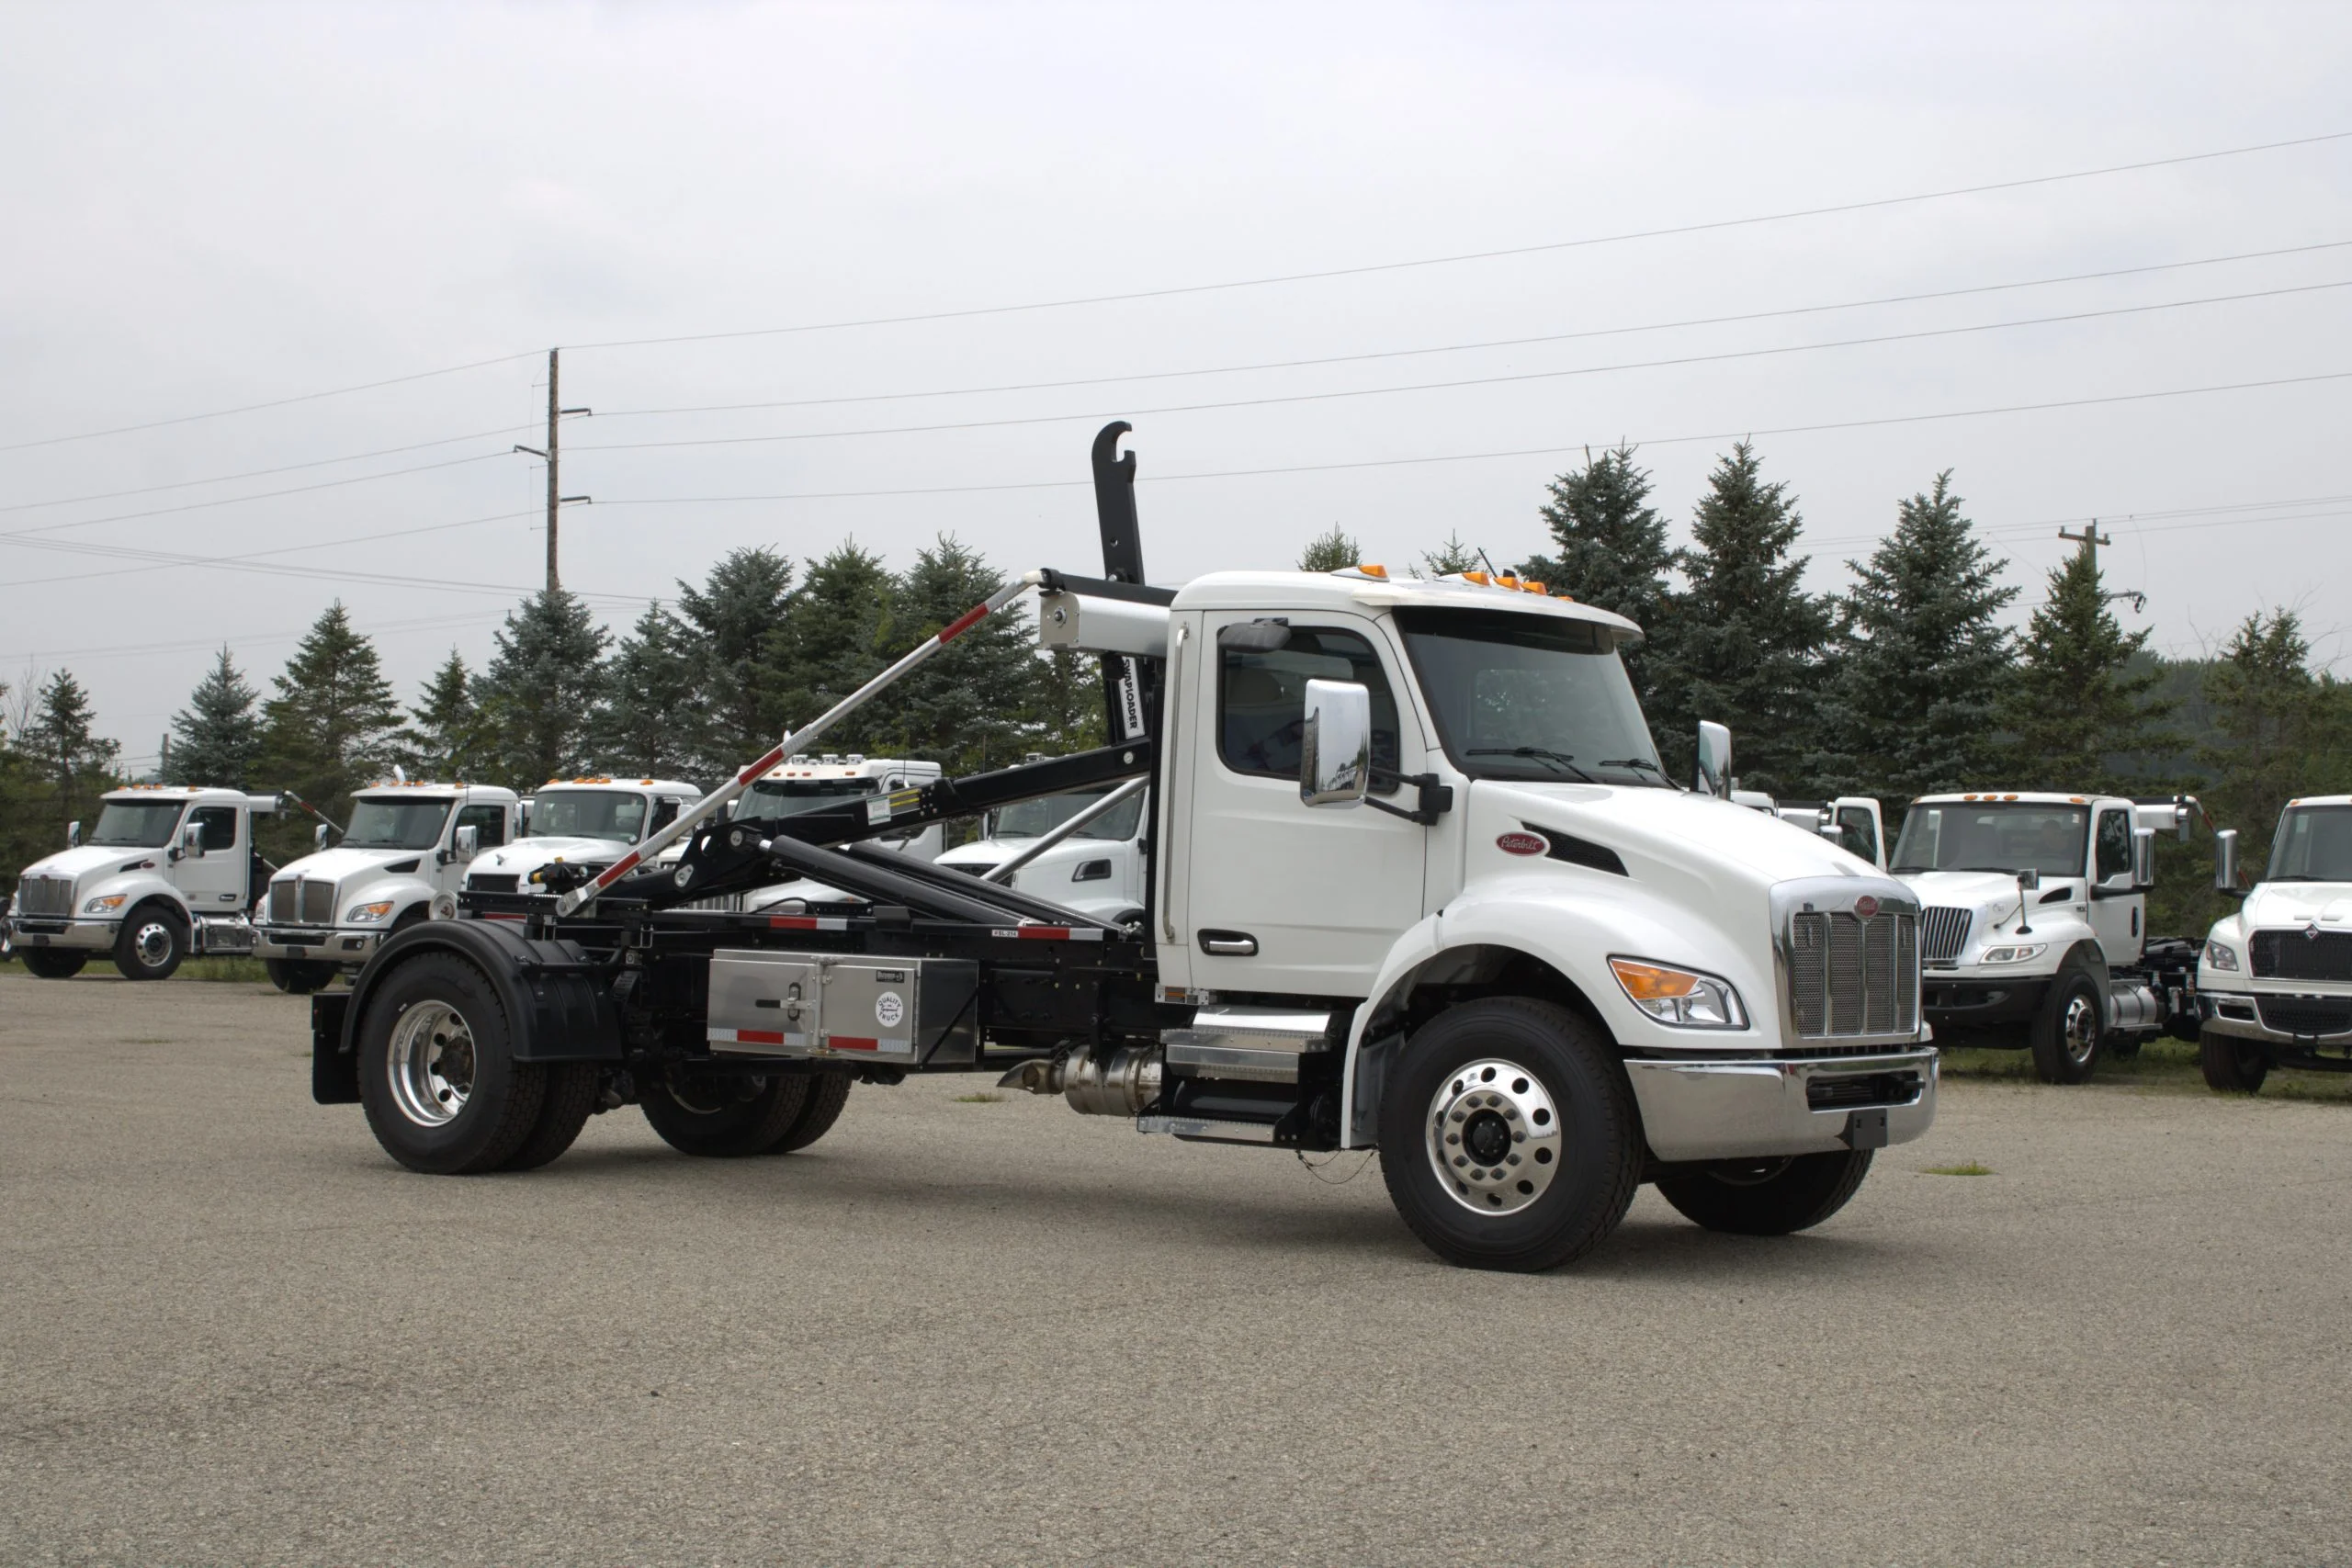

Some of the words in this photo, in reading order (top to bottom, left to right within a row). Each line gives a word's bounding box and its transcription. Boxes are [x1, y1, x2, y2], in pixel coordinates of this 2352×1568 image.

[1124, 659, 1137, 729] SWAPLOADER
[1501, 836, 1541, 850] Peterbilt
[878, 997, 901, 1007] QUALITY
[879, 1011, 899, 1021] TRUCK
